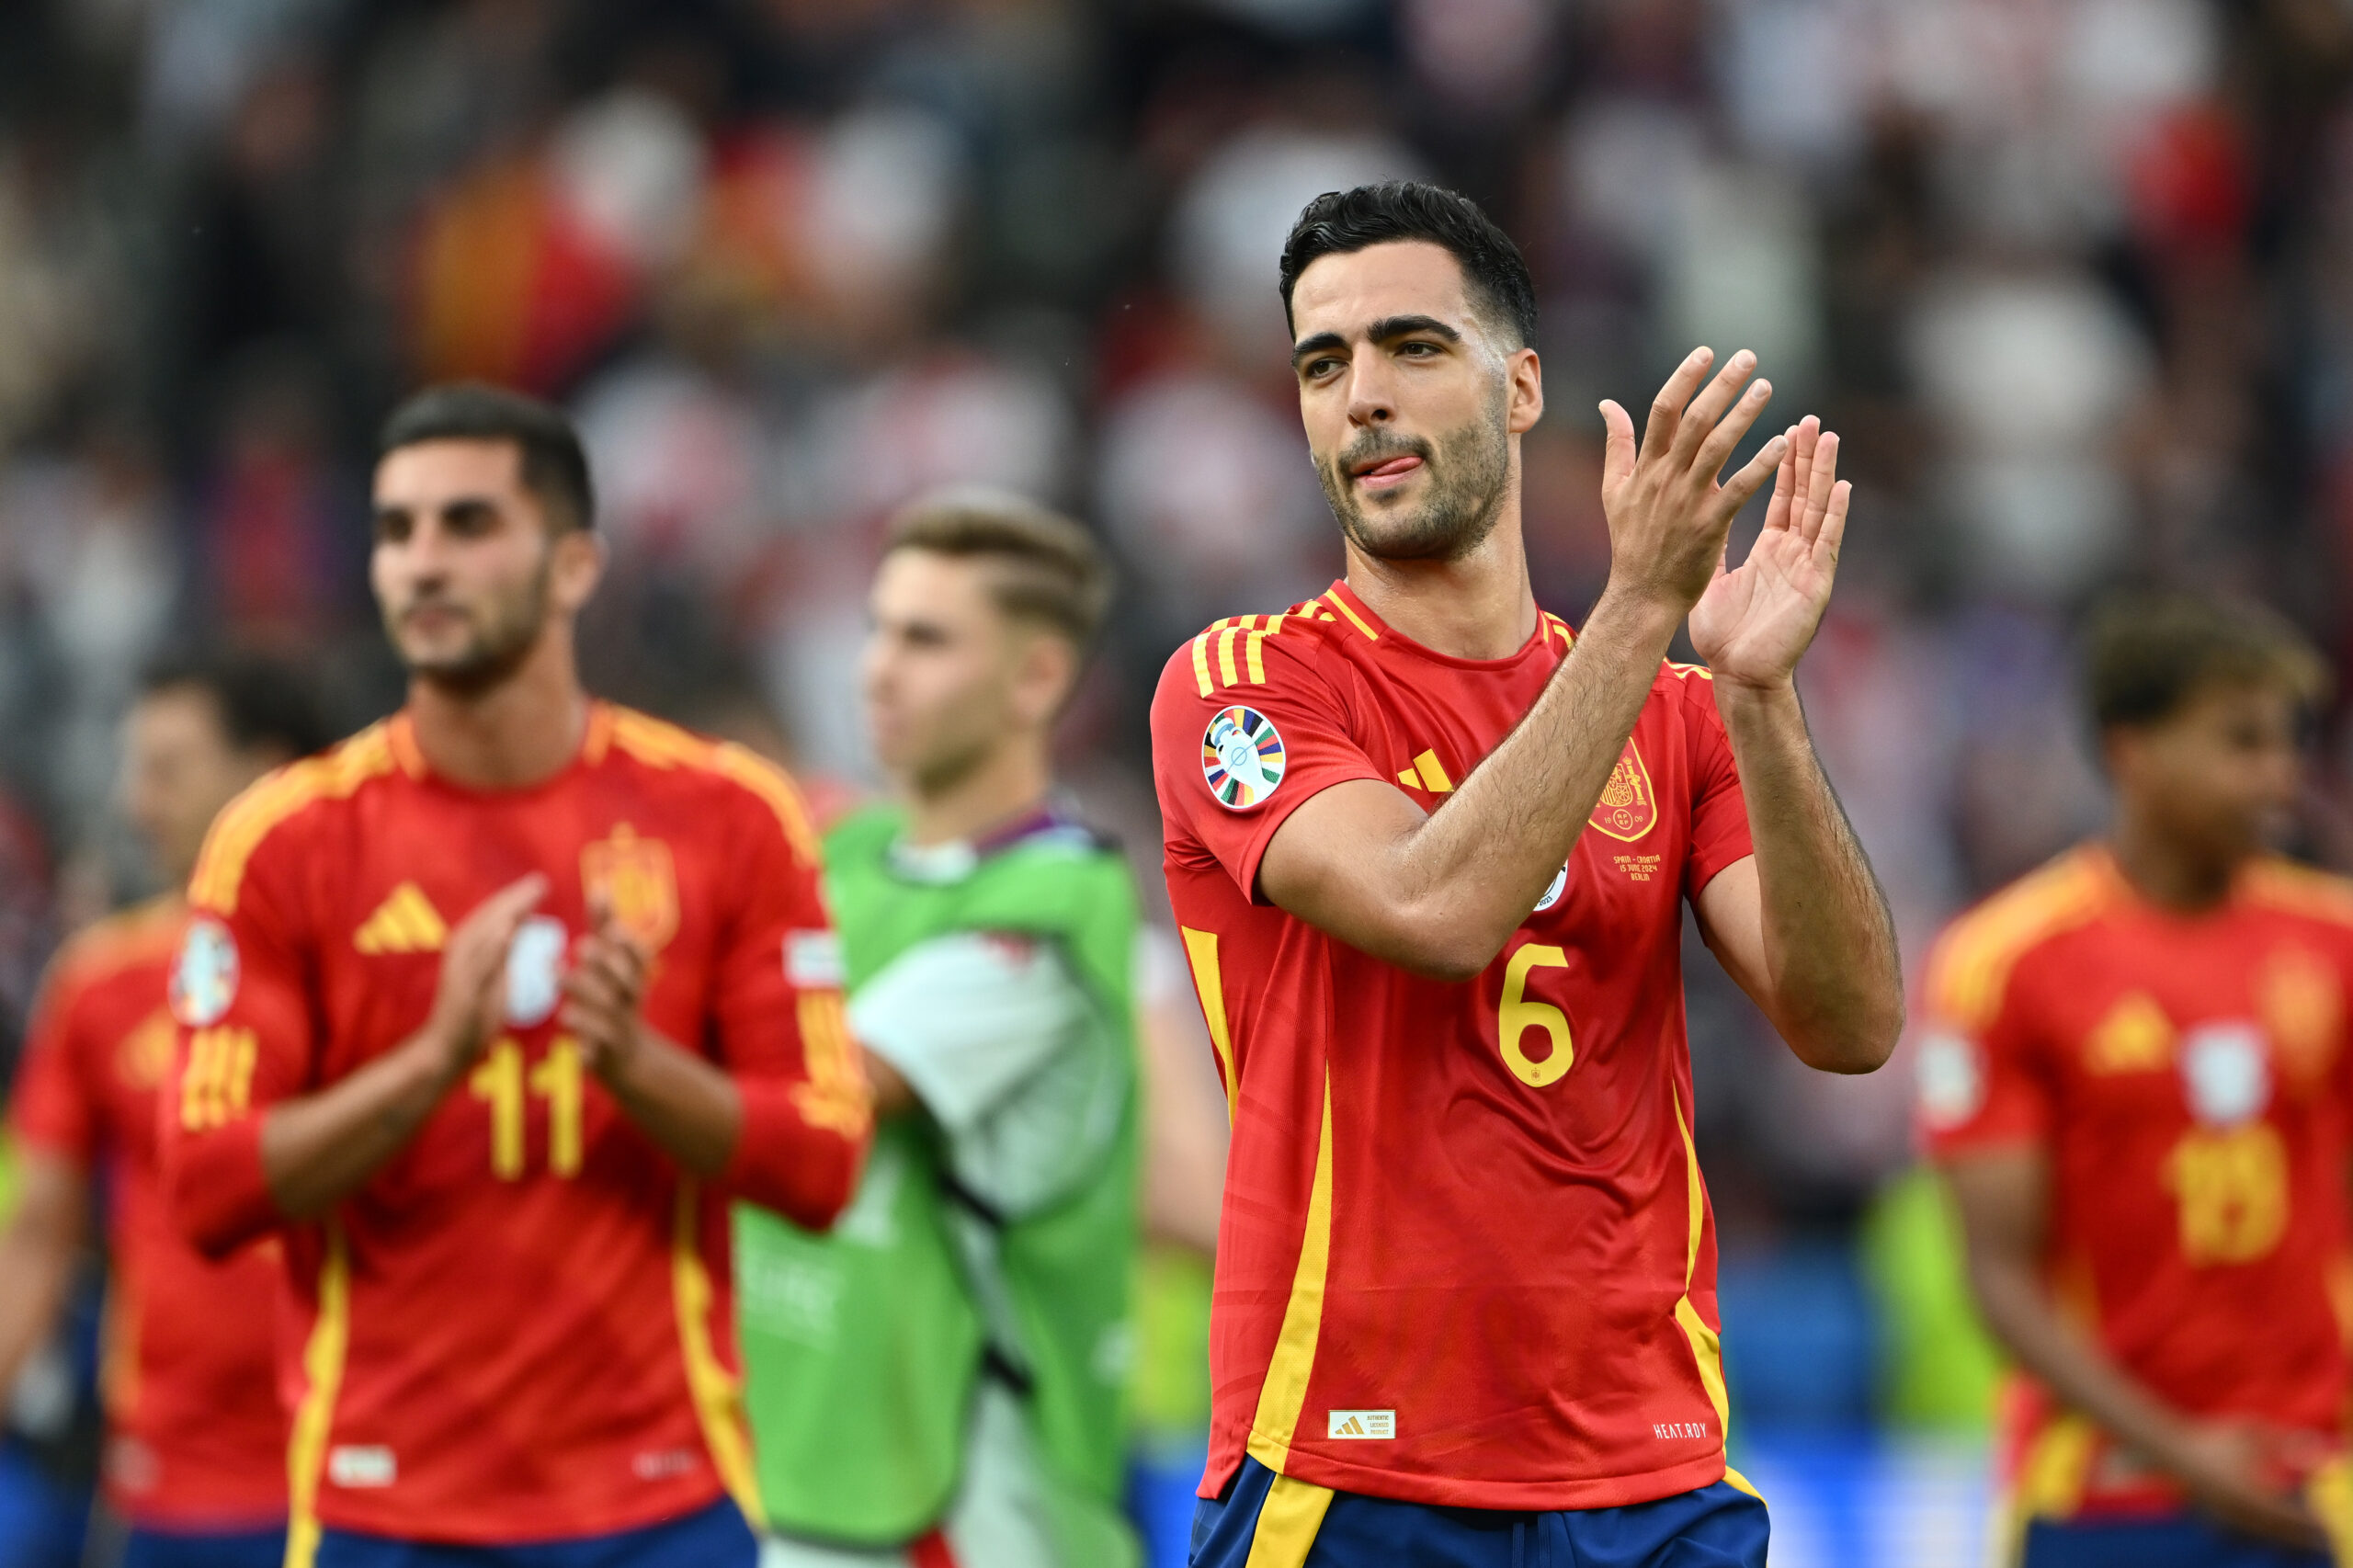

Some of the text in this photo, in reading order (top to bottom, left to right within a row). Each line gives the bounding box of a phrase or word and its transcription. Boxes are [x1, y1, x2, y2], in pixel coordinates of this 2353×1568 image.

[1613, 856, 1631, 864] SPAIN
[1636, 855, 1661, 864] CROATIA
[1620, 864, 1658, 873] 15 JUNE 2024
[1631, 873, 1650, 881] BERLIN
[1499, 943, 1574, 1087] 6
[470, 1036, 585, 1182] 11
[1654, 1422, 1707, 1439] HEAT.RDY
